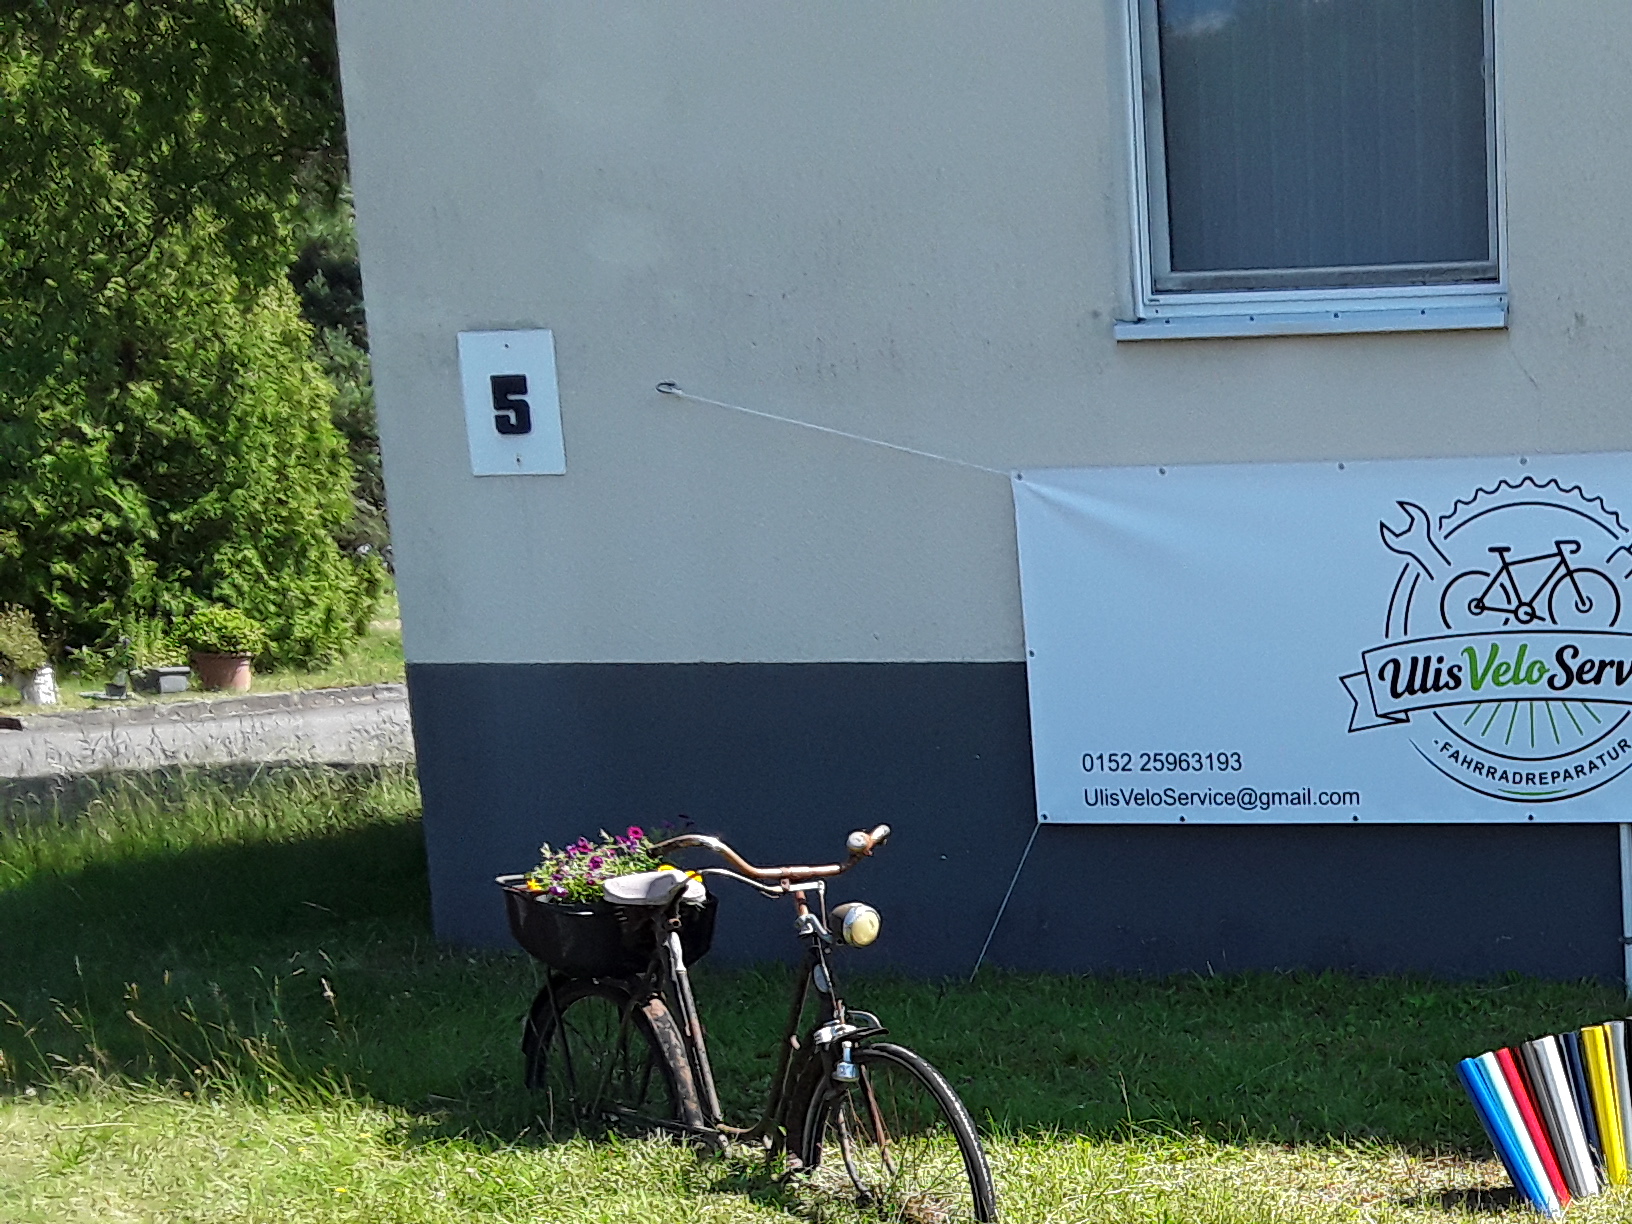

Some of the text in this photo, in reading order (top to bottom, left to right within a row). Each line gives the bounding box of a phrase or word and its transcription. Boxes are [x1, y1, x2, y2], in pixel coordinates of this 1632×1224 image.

[489, 374, 532, 435] 5
[1082, 752, 1243, 772] 0152 25963193
[1084, 787, 1361, 811] UlisVeloService@gmail.com
